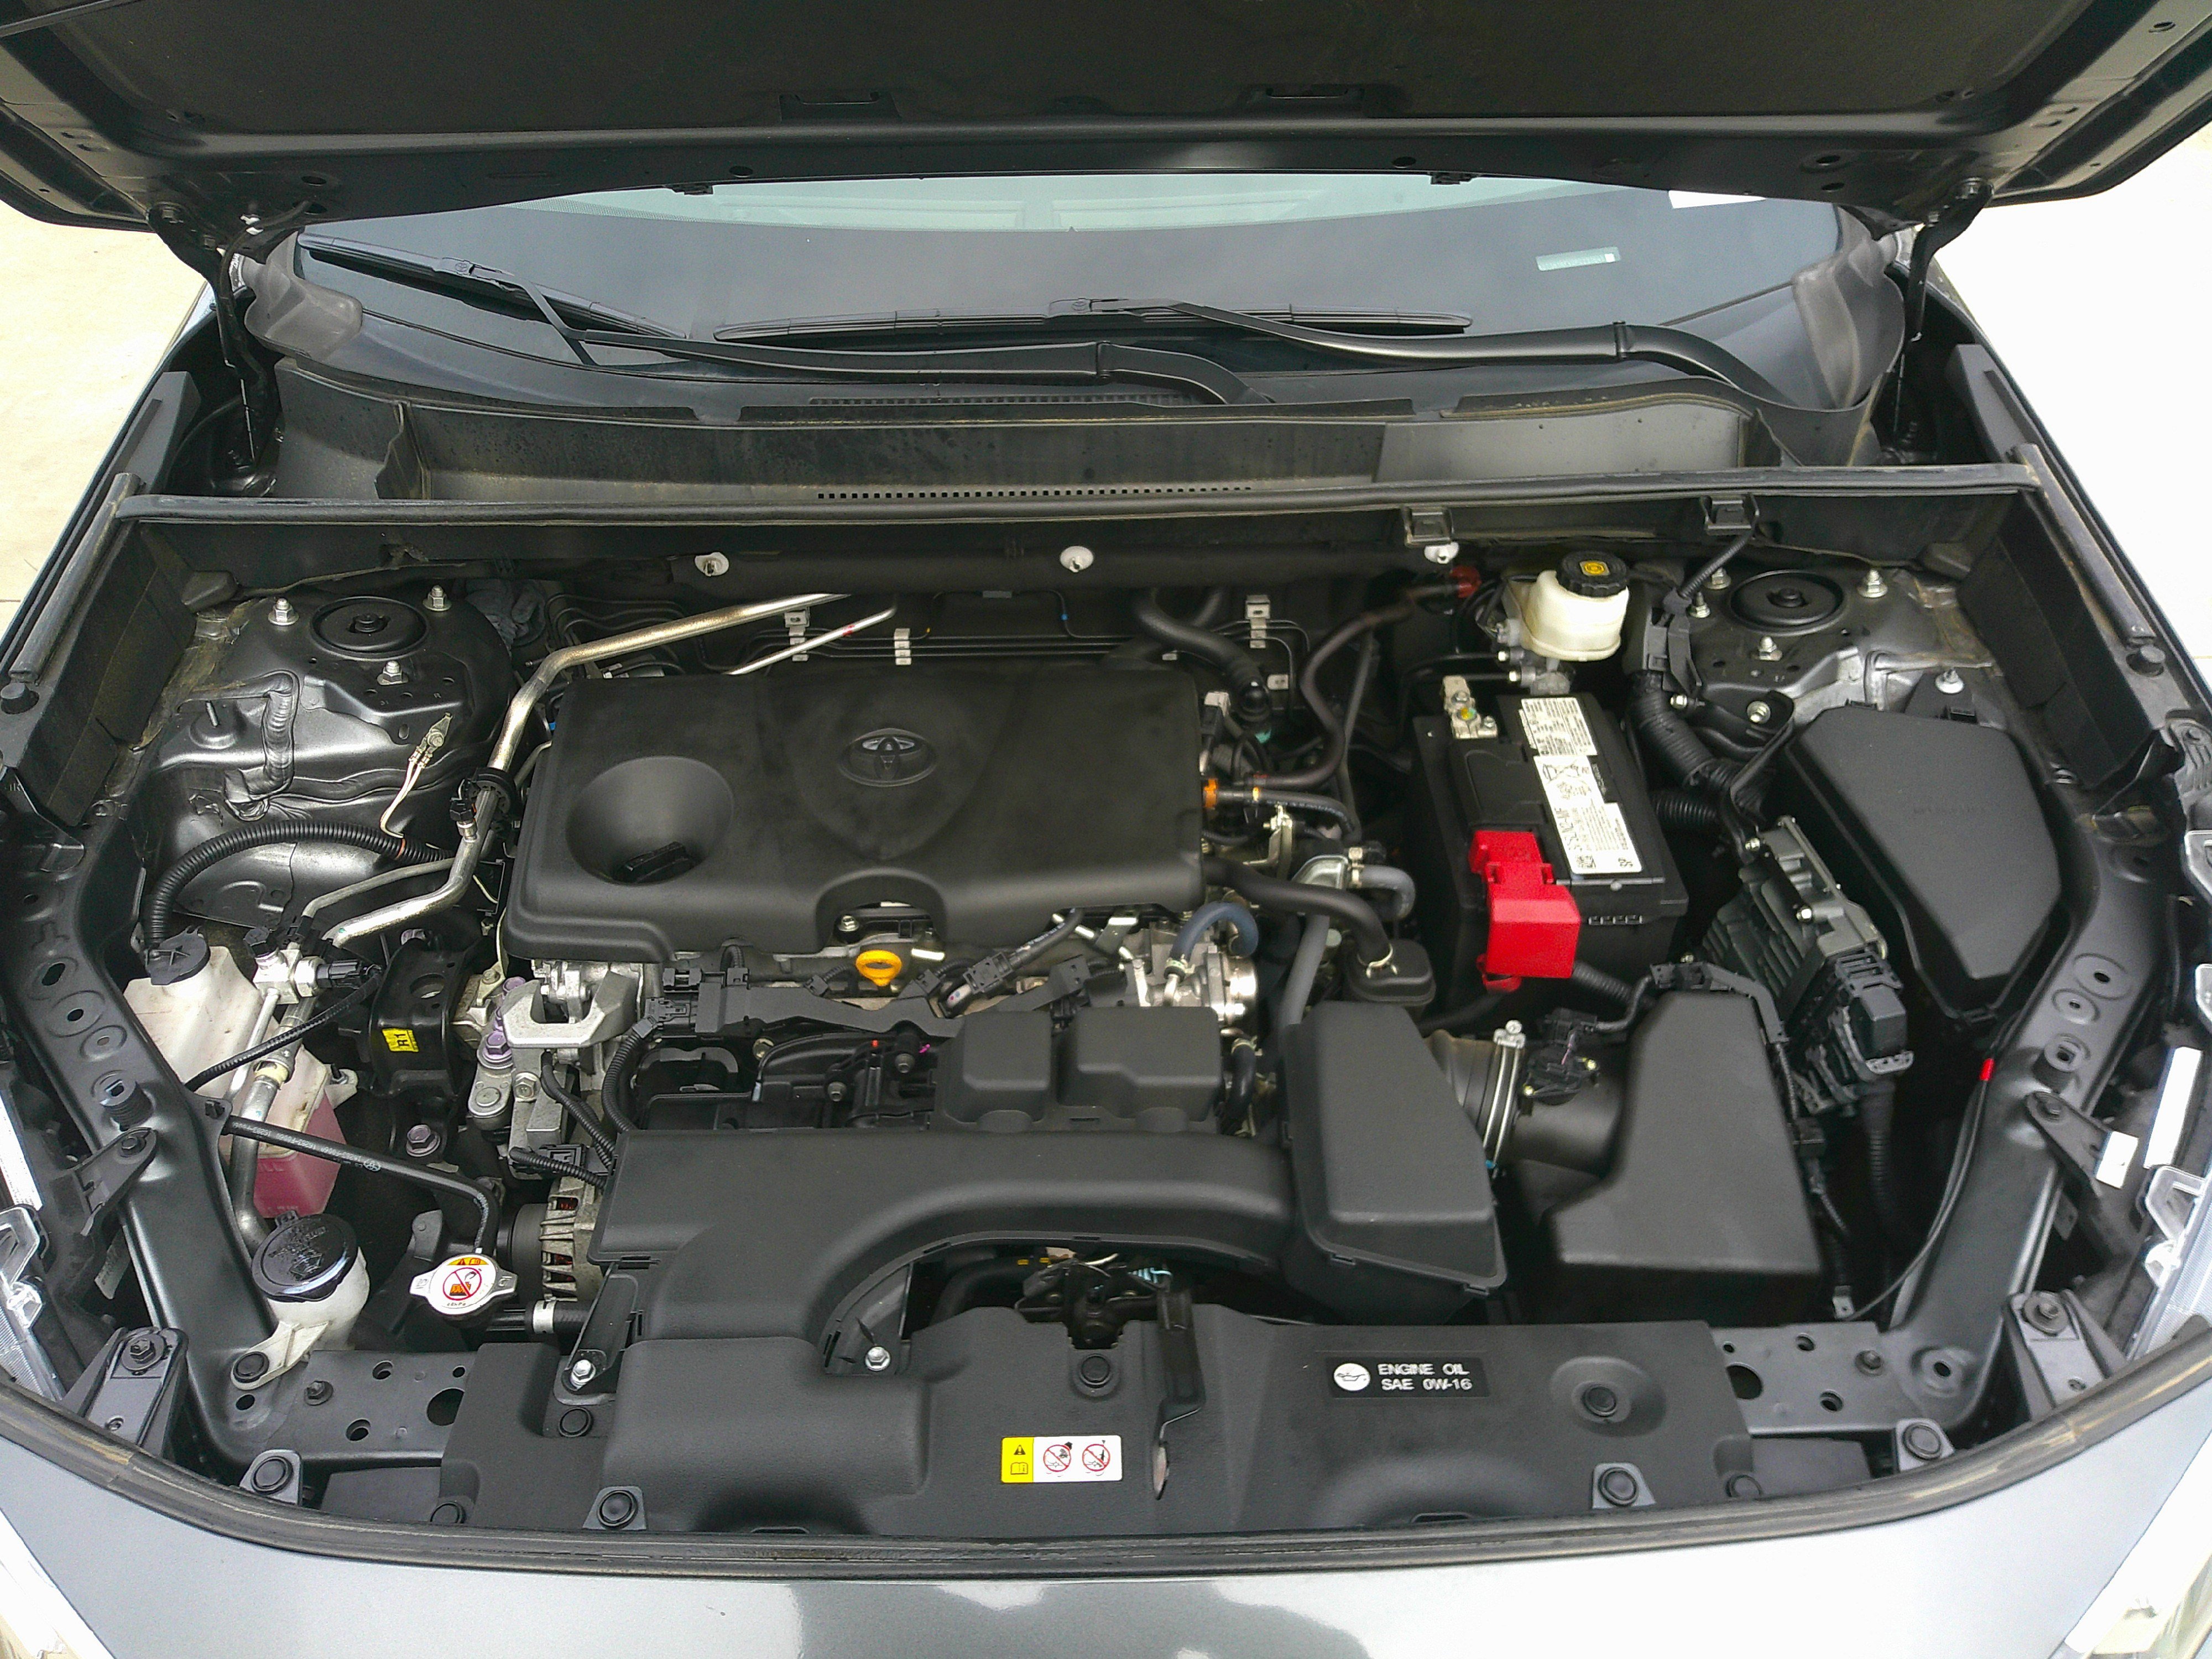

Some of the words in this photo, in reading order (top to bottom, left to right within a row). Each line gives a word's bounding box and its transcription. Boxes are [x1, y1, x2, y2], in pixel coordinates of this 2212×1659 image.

[393, 1034, 410, 1047] R1
[1378, 1363, 1435, 1375] ENGINE
[1442, 1363, 1470, 1375] OIL
[1381, 1378, 1415, 1391] SAE
[1422, 1378, 1473, 1391] 0W-16
